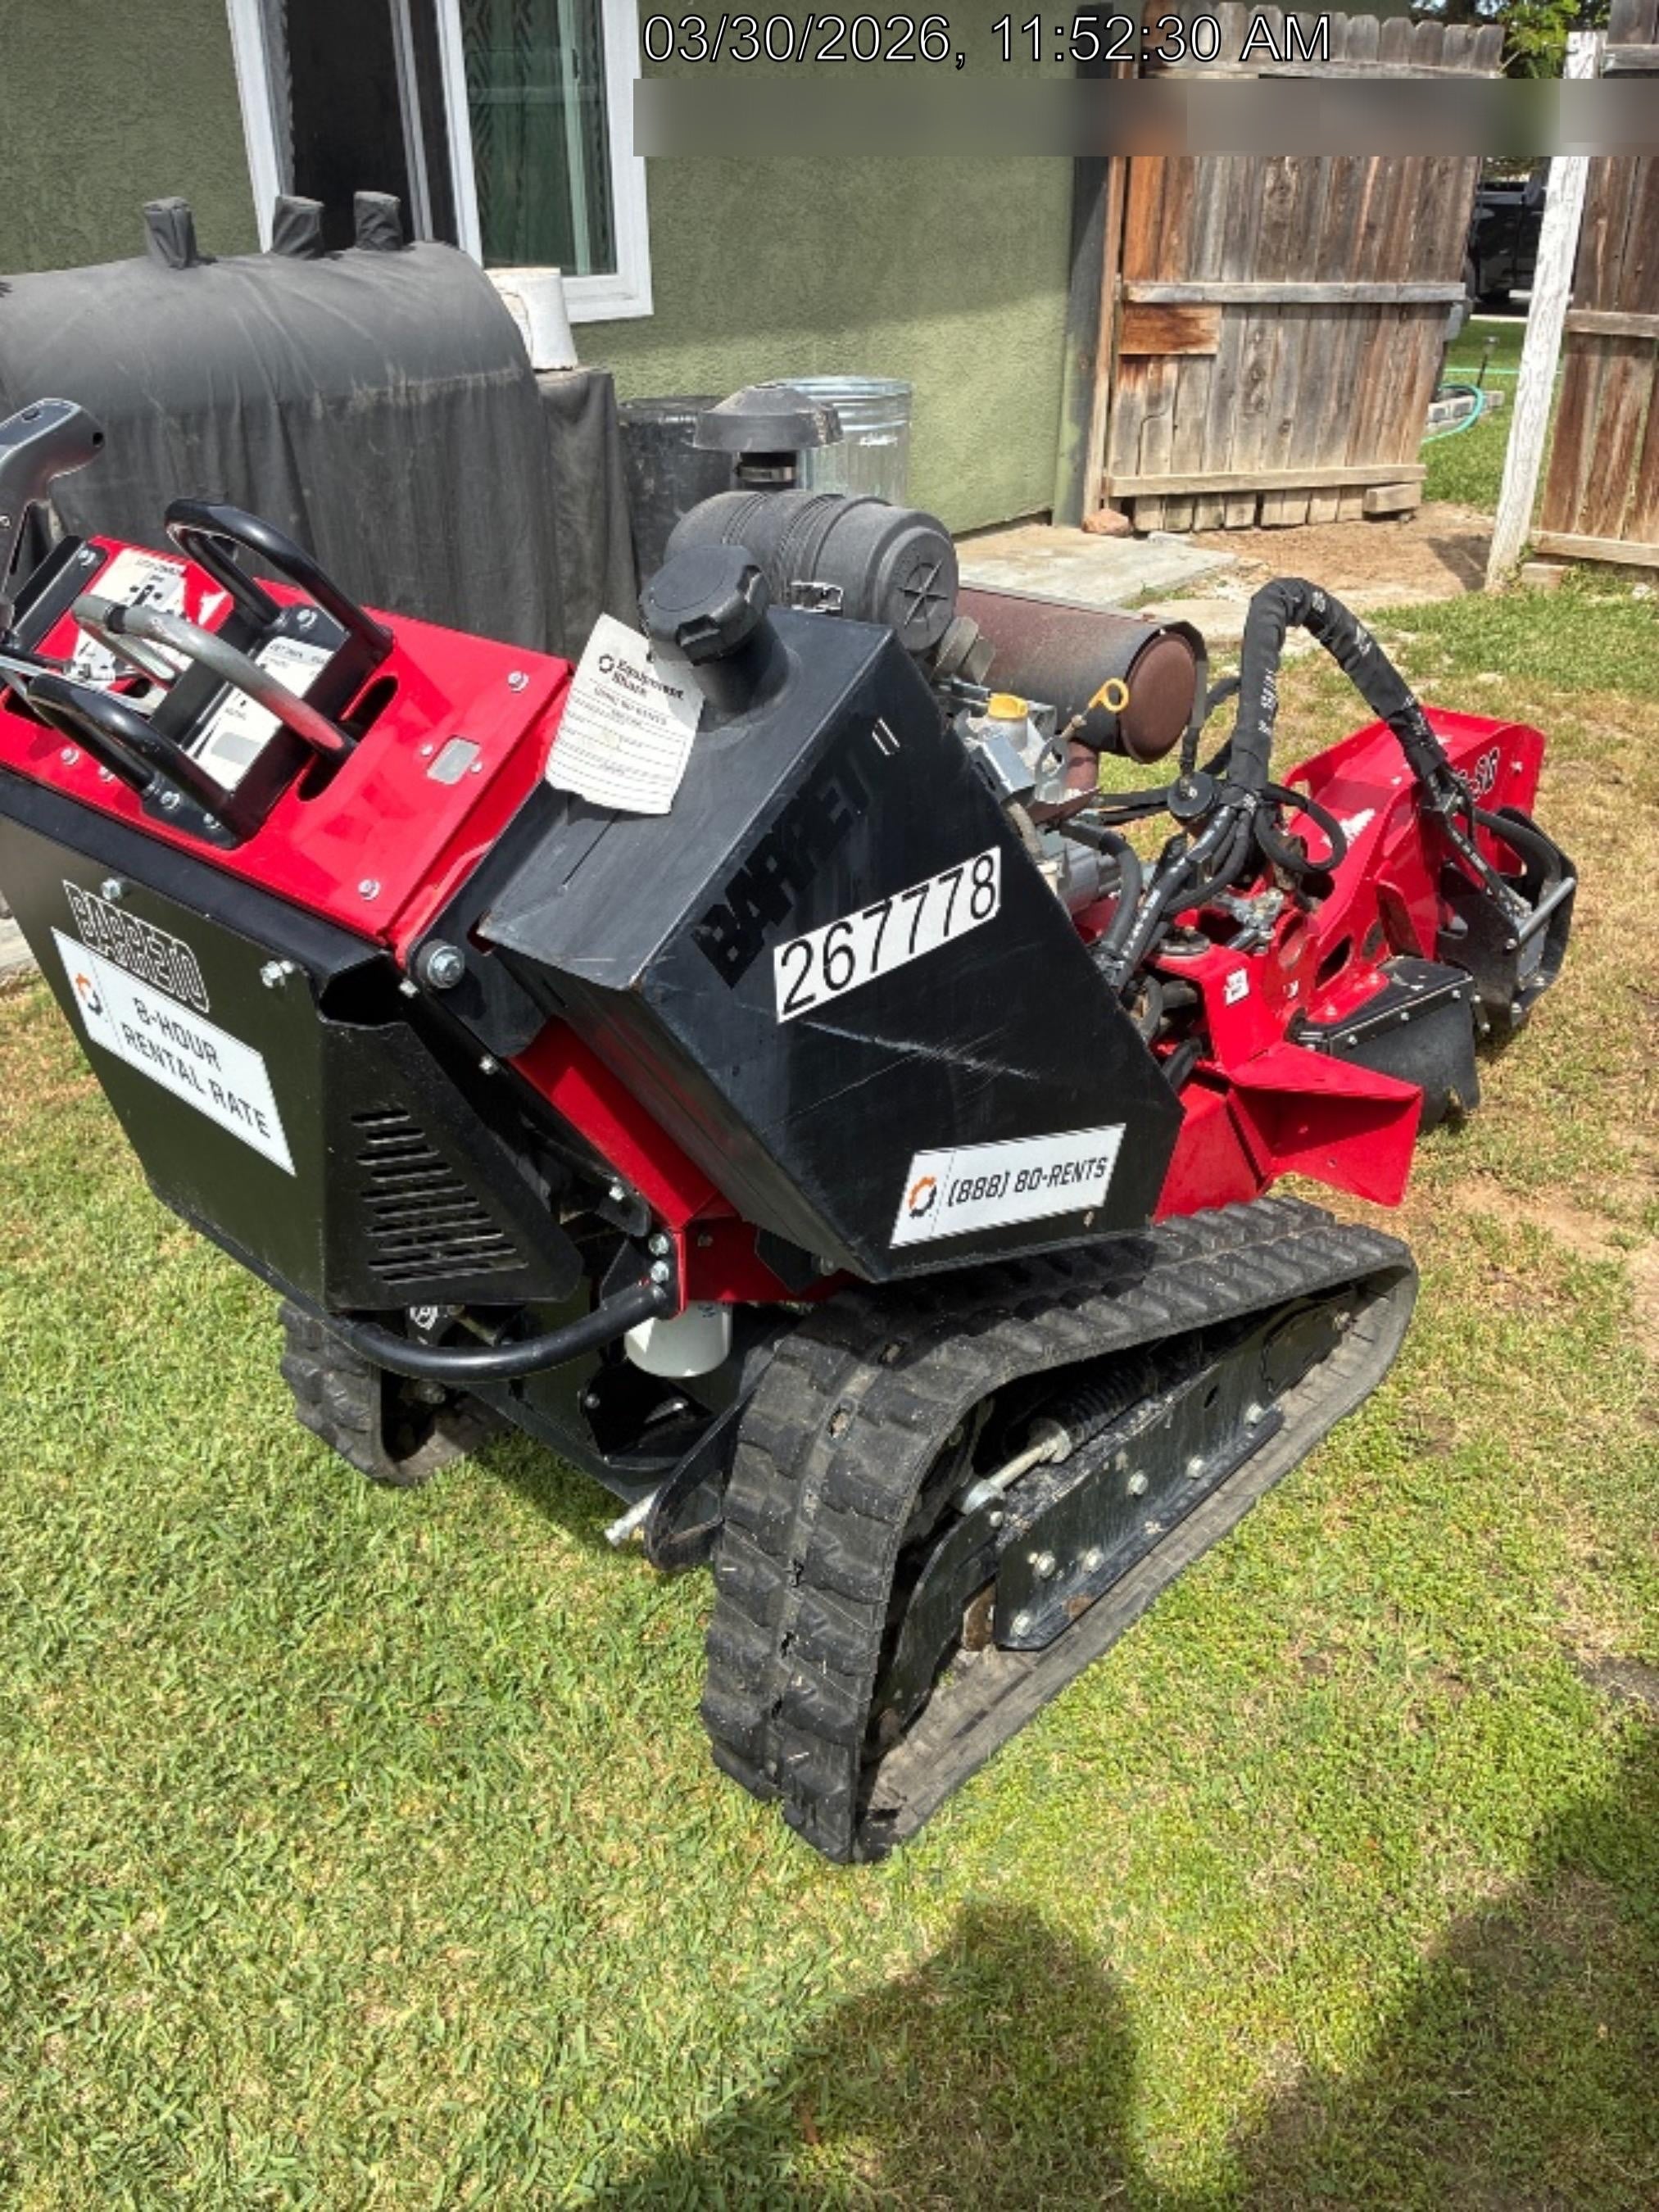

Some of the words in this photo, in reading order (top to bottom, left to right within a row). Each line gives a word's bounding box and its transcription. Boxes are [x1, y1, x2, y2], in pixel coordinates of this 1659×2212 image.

[780, 854, 997, 1015] 267778
[120, 1022, 207, 1095] RENTAL
[207, 1077, 272, 1139] RATE
[132, 996, 222, 1072] 8-HOUR
[947, 1171, 1011, 1208] (888)
[1013, 1156, 1108, 1194] 80-RENTS
